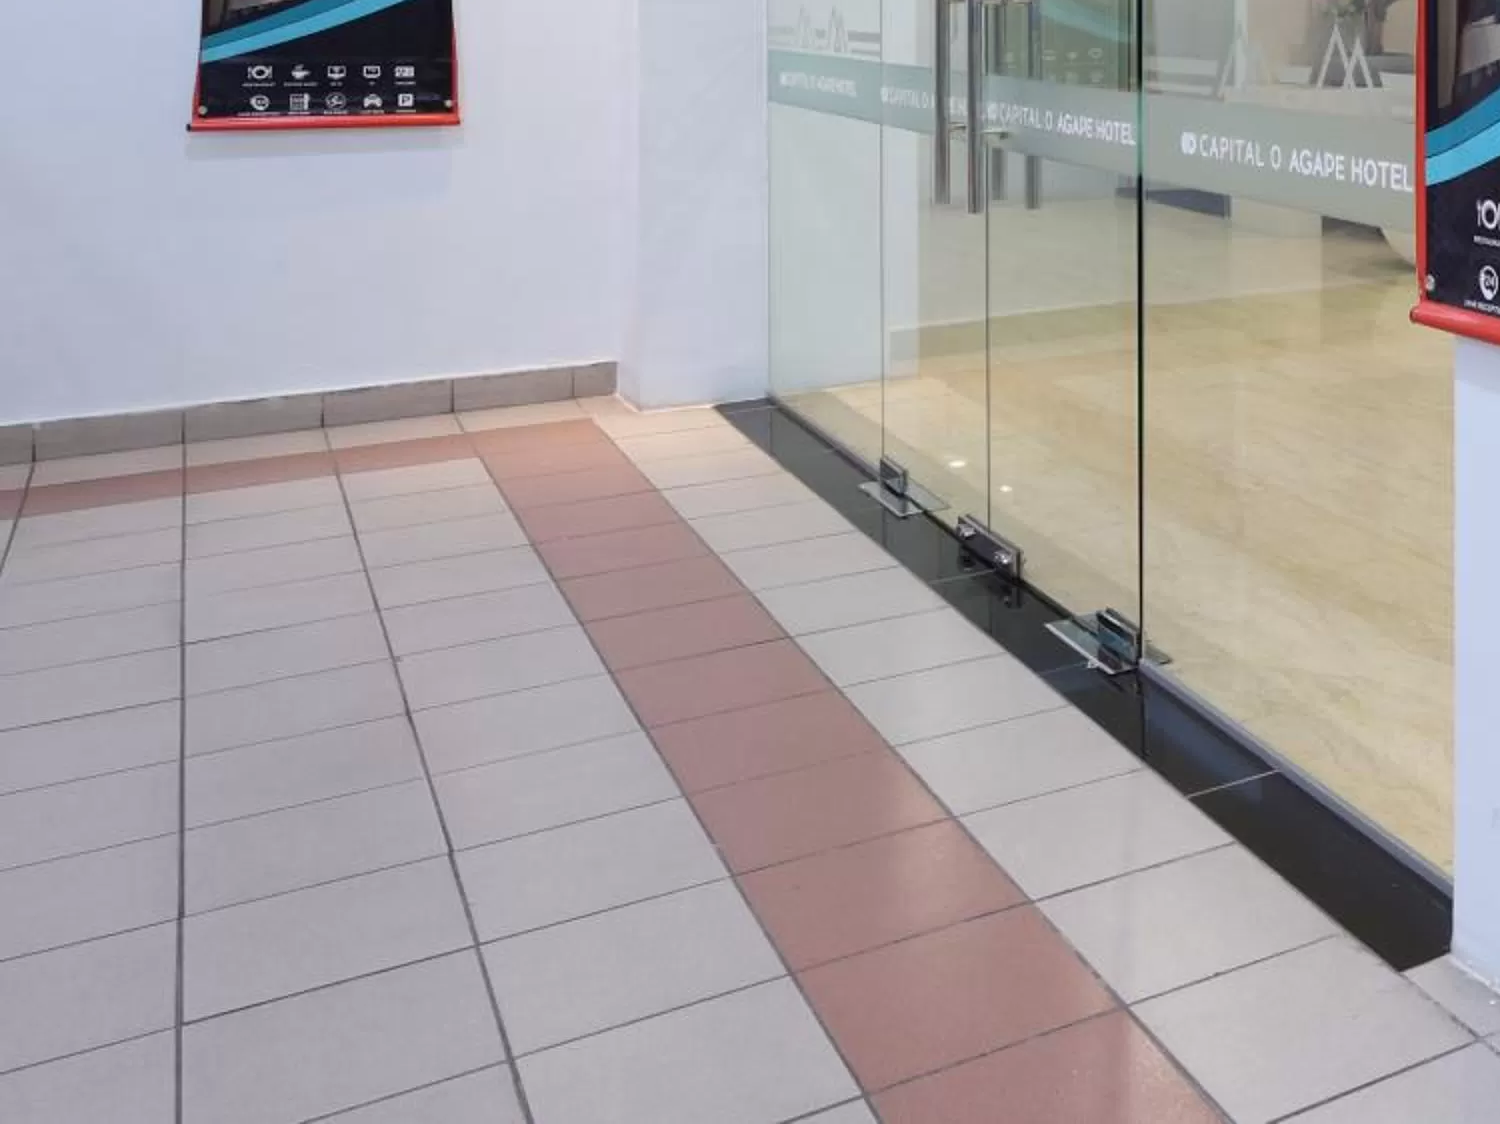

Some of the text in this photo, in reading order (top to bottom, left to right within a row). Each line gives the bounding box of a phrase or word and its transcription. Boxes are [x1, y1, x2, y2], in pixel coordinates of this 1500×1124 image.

[999, 102, 1041, 129] CAPITAL
[1057, 112, 1093, 139] AGAPE
[1095, 118, 1137, 146] HOTEL
[1199, 133, 1413, 192] CAPITAL O AGAPE HOTEL
